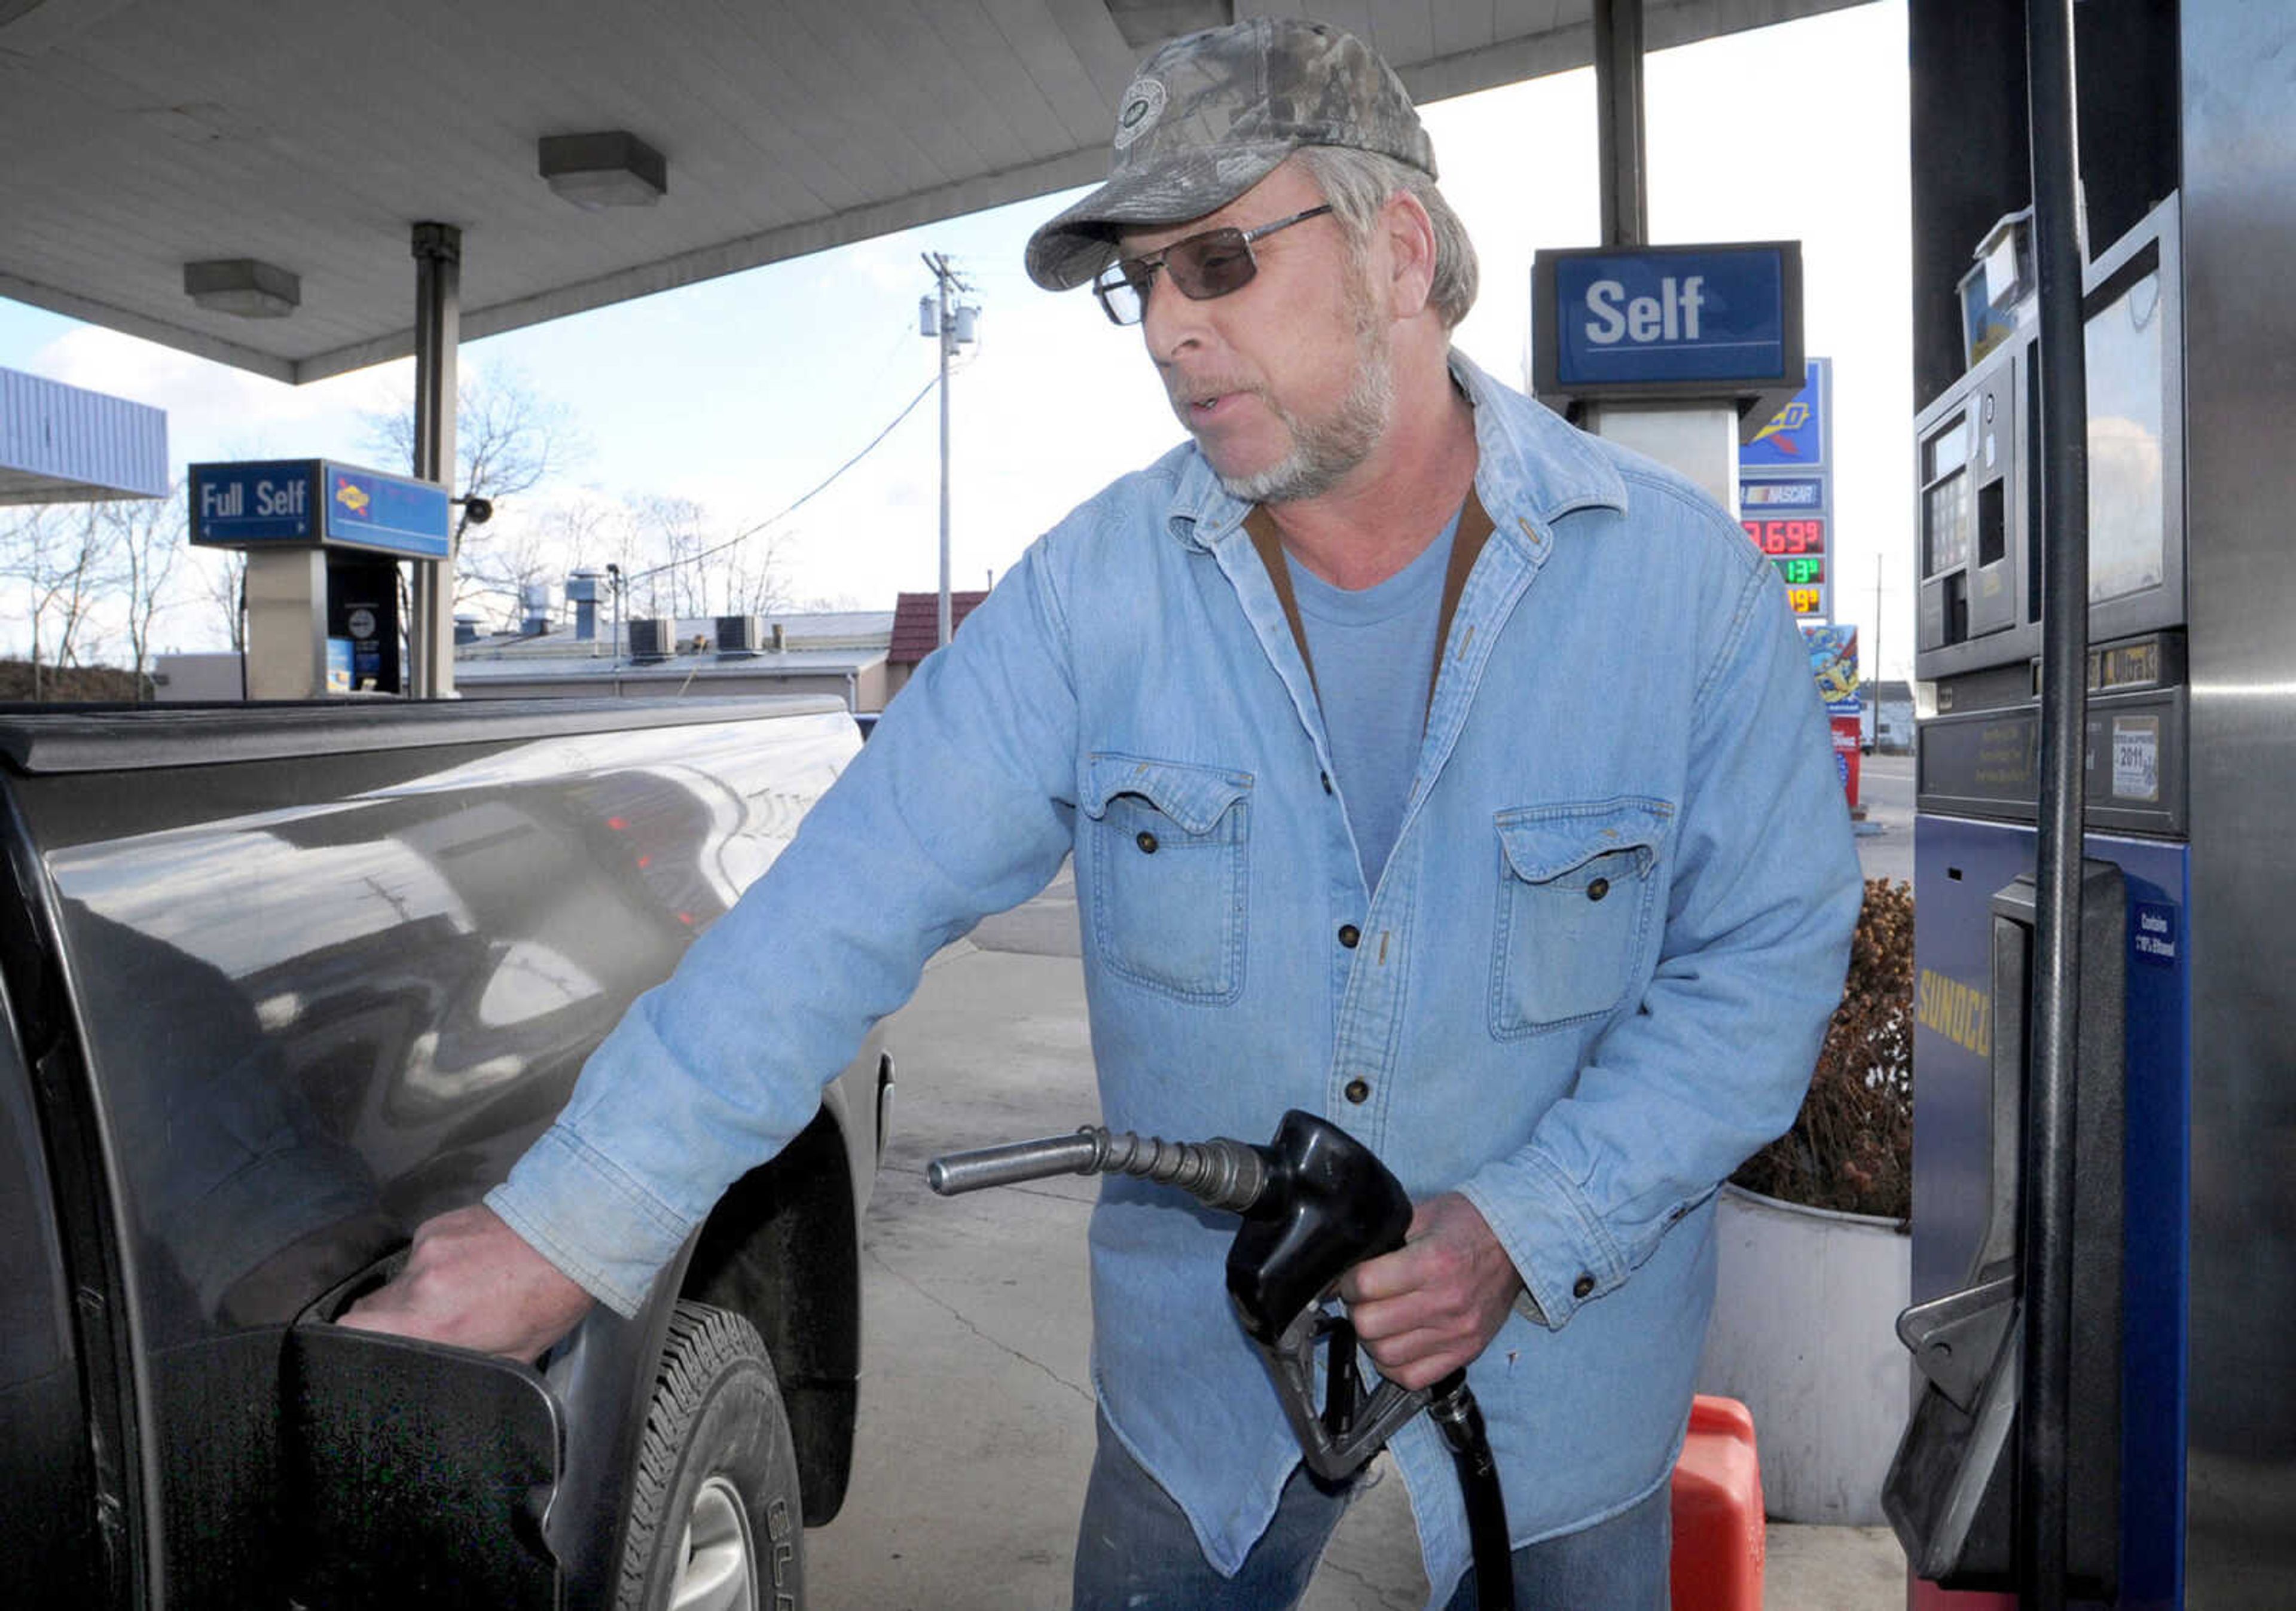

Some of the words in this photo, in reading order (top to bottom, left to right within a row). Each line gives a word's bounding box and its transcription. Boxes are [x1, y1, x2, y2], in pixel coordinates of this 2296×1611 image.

[1585, 276, 1705, 344] Self
[201, 482, 243, 517] Full
[257, 480, 306, 516] Self
[2120, 746, 2142, 769] 2011
